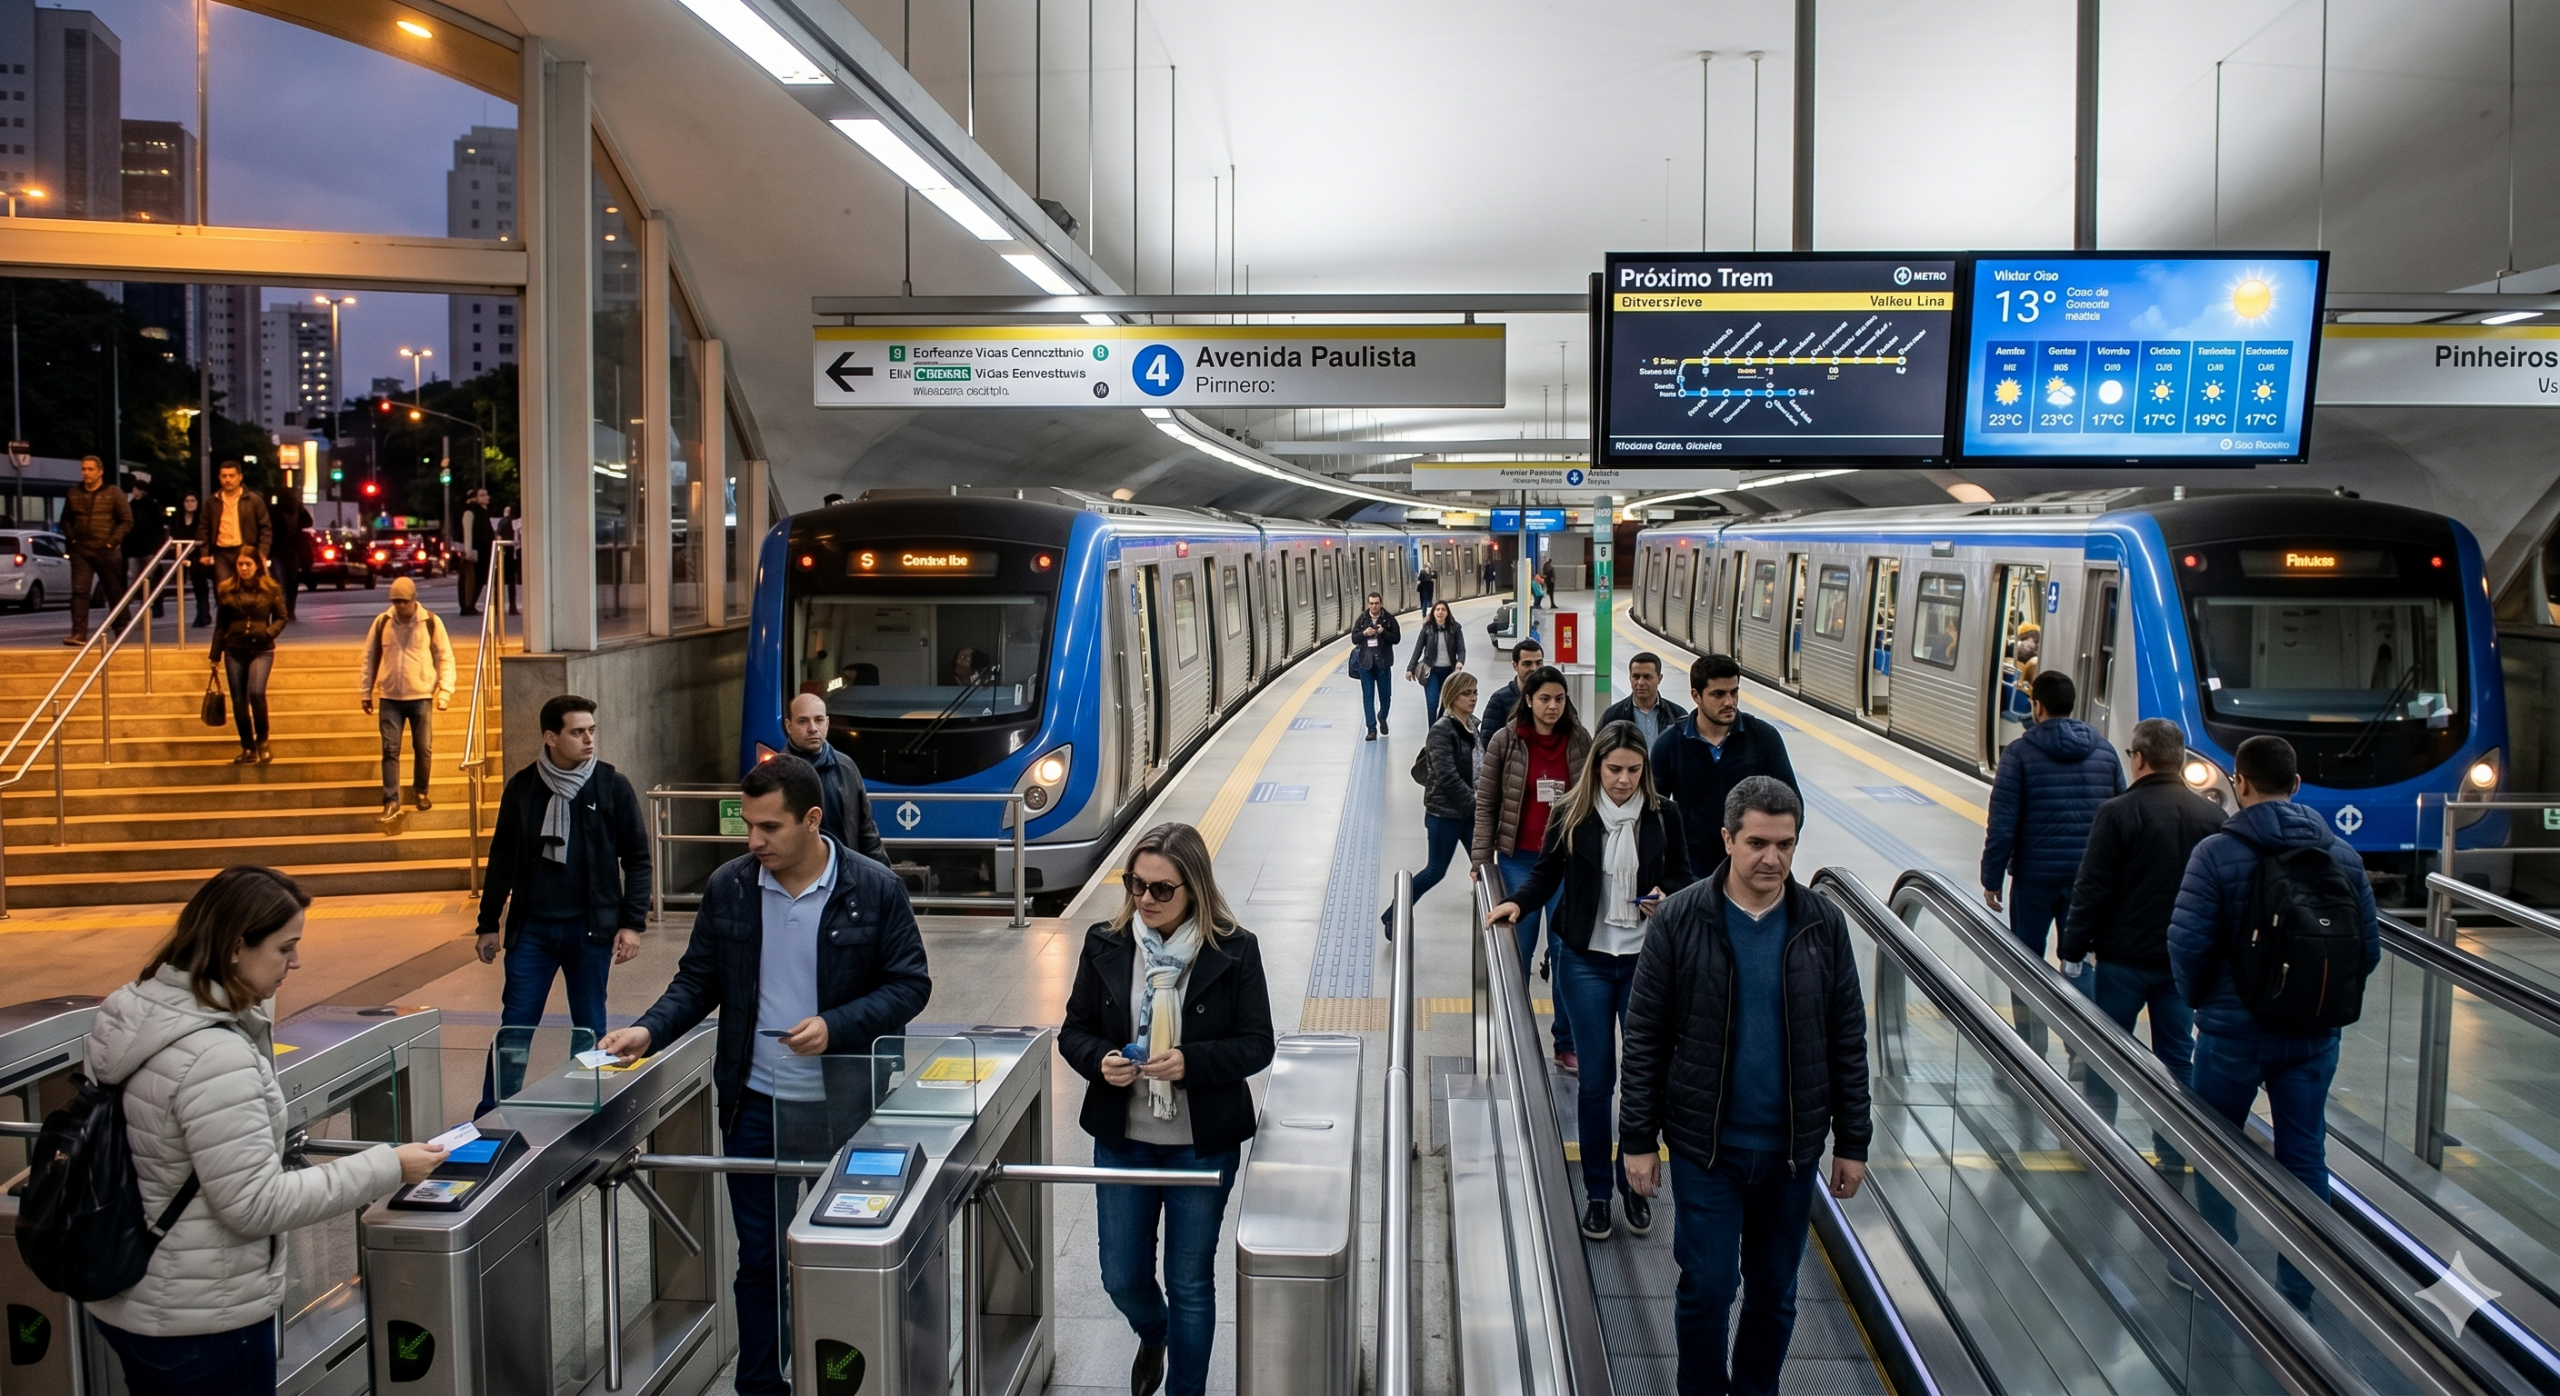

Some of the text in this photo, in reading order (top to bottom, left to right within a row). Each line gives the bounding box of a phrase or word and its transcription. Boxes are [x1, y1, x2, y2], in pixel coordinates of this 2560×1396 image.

[1620, 267, 1773, 287] Próximo Trem
[1913, 272, 1947, 281] METRO
[1917, 295, 1945, 307] Lina
[1995, 289, 2057, 323] 13°
[893, 347, 902, 359] 9
[1195, 346, 1417, 368] Avenida Paulista
[2435, 345, 2559, 367] Pinheiros
[1145, 353, 1170, 387] 4
[1988, 413, 2023, 426] 23°C
[2040, 413, 2074, 426] 23°C
[2092, 413, 2125, 426] 17°C
[2143, 413, 2176, 426] 17°C
[2194, 413, 2227, 426] 19°C
[2244, 413, 2278, 426] 17°C
[1600, 546, 1607, 558] 6
[861, 552, 874, 567] S
